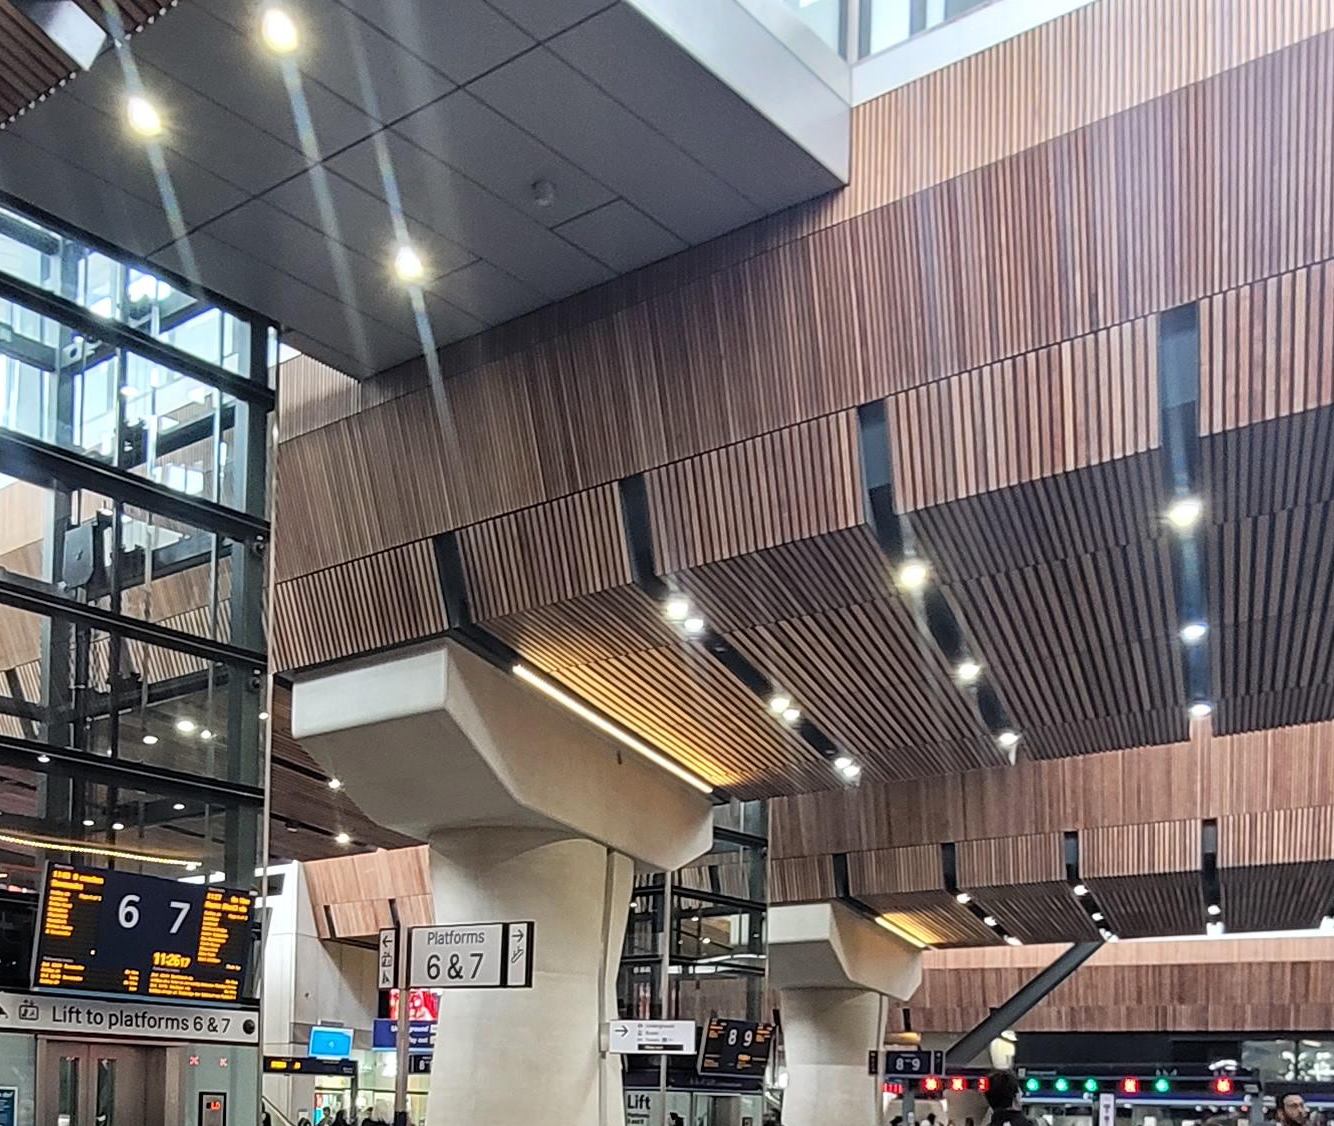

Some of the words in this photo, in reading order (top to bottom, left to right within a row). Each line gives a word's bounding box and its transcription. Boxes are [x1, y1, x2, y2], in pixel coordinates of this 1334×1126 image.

[118, 894, 141, 929] 6
[169, 901, 191, 934] 7
[427, 930, 485, 945] Platforms
[427, 954, 441, 980] 6
[447, 953, 464, 980] &
[469, 952, 484, 979] 7
[52, 1005, 82, 1024] Lift
[86, 1008, 104, 1025] to
[108, 1009, 190, 1031] platforms
[193, 1015, 204, 1032] 6
[207, 1016, 219, 1033] &
[221, 1018, 231, 1034] 7
[728, 1029, 738, 1046] 8
[743, 1030, 753, 1047] 9
[627, 1094, 651, 1110] Lift
